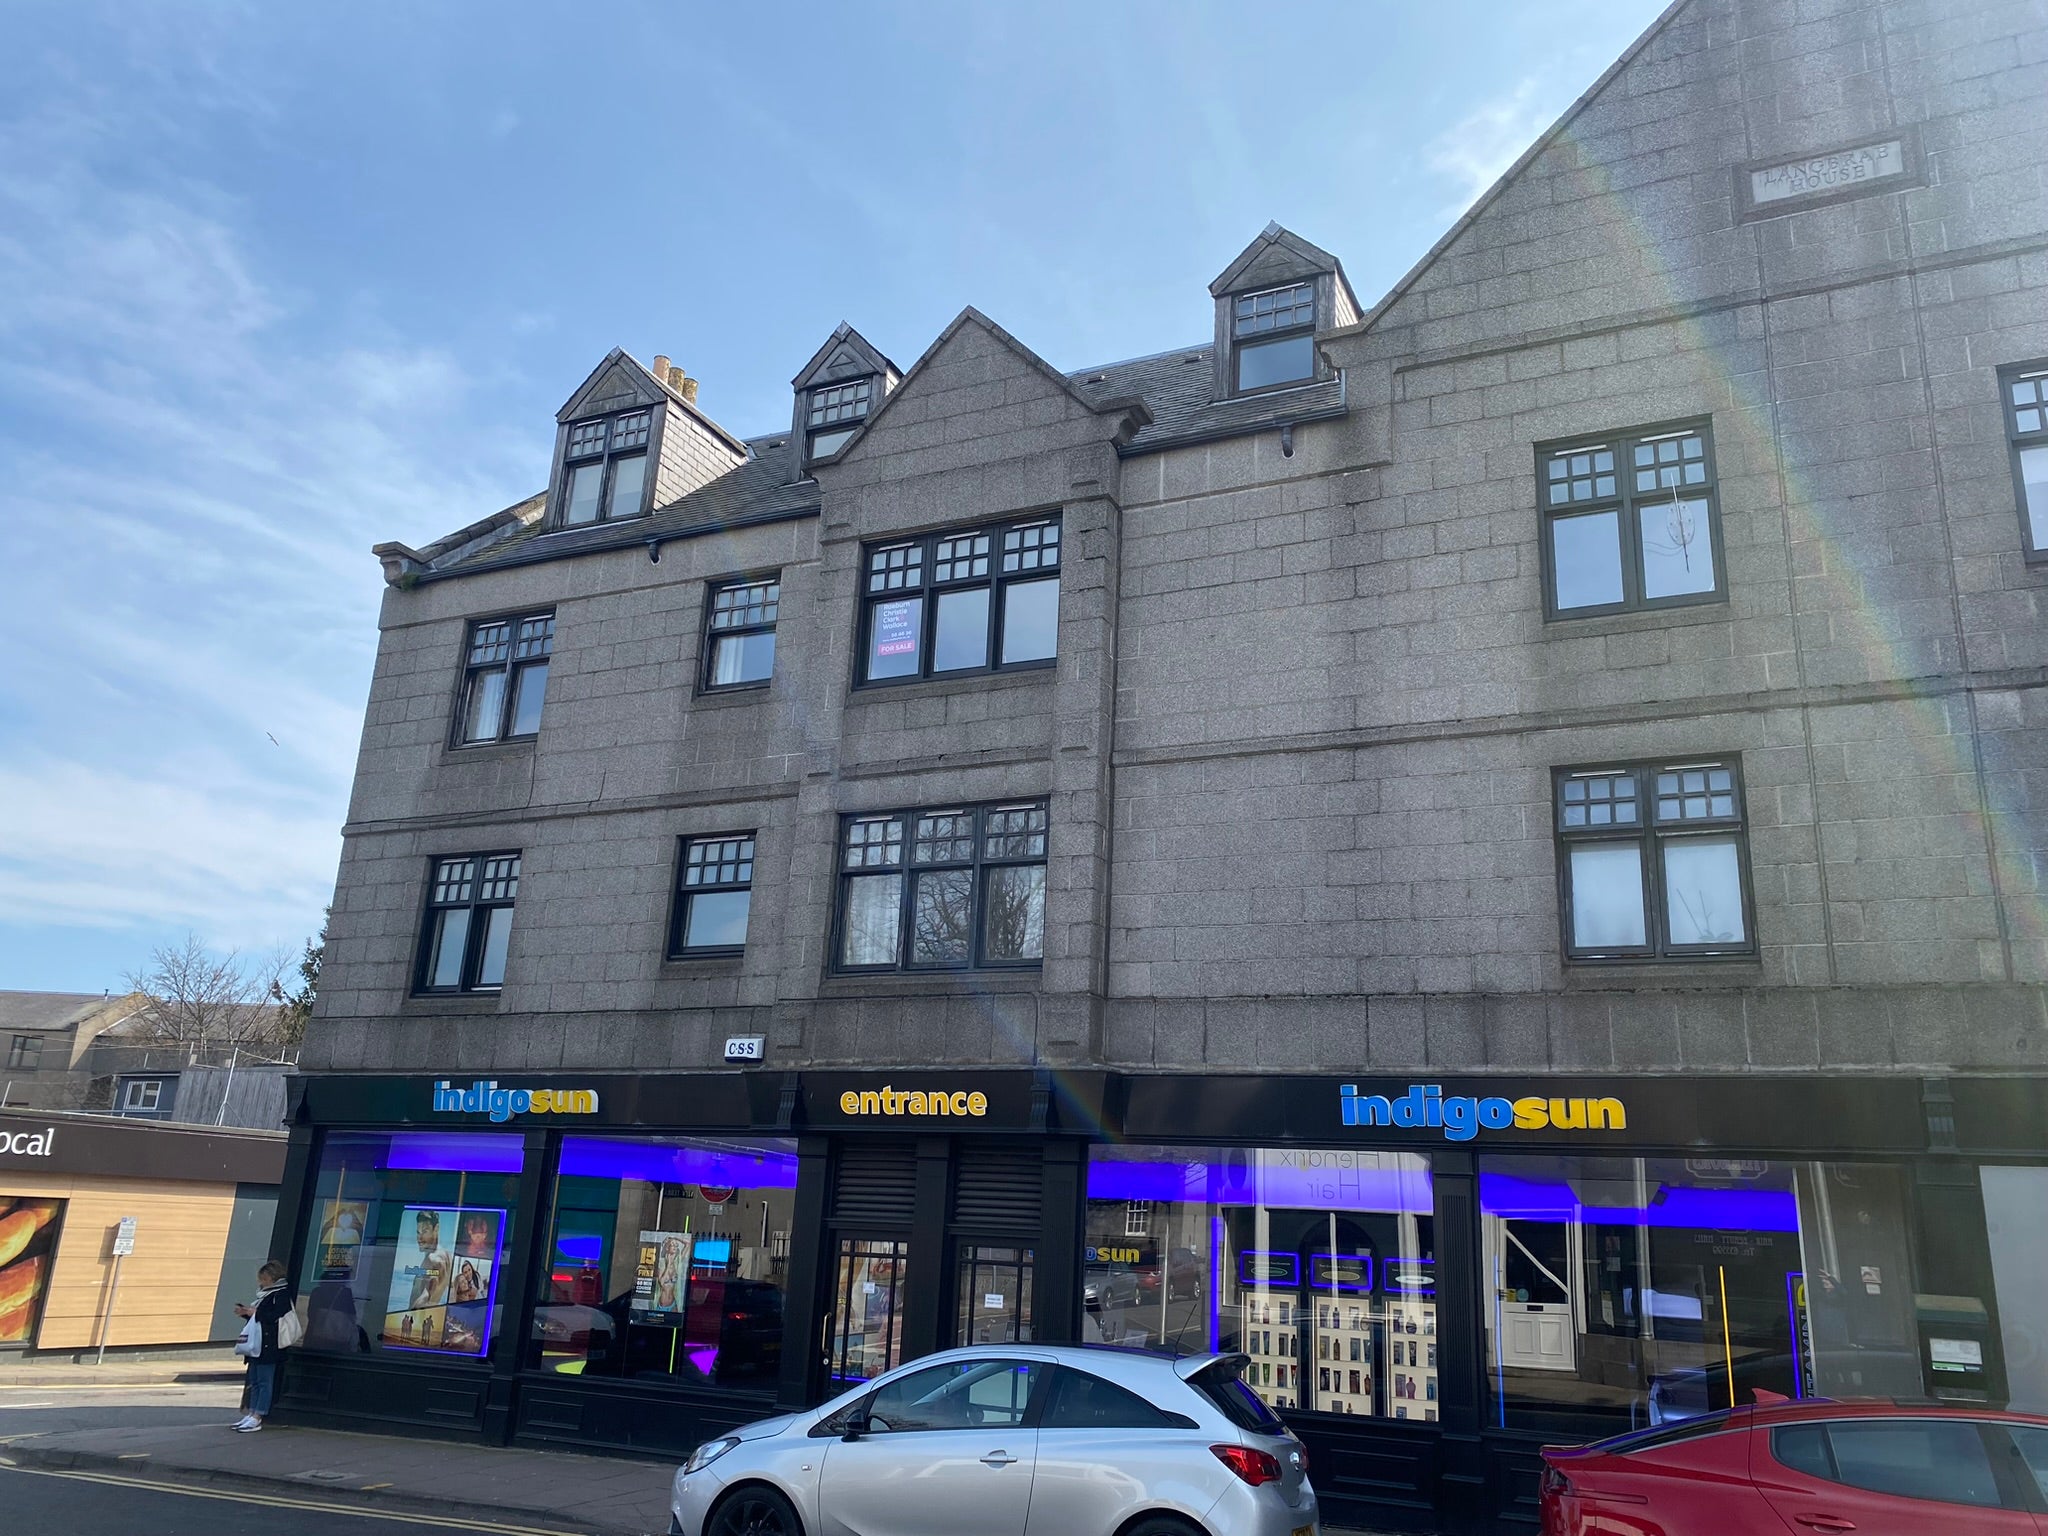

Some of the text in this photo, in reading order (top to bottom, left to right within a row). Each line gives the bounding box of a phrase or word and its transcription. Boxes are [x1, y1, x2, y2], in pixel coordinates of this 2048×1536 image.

[1792, 165, 1866, 191] HOUSE
[895, 642, 912, 650] SALE
[433, 1081, 599, 1123] indigosun
[840, 1085, 988, 1117] entrance
[1340, 1084, 1627, 1141] indigosun
[0, 1127, 55, 1157] ocal
[640, 1247, 656, 1264] 15
